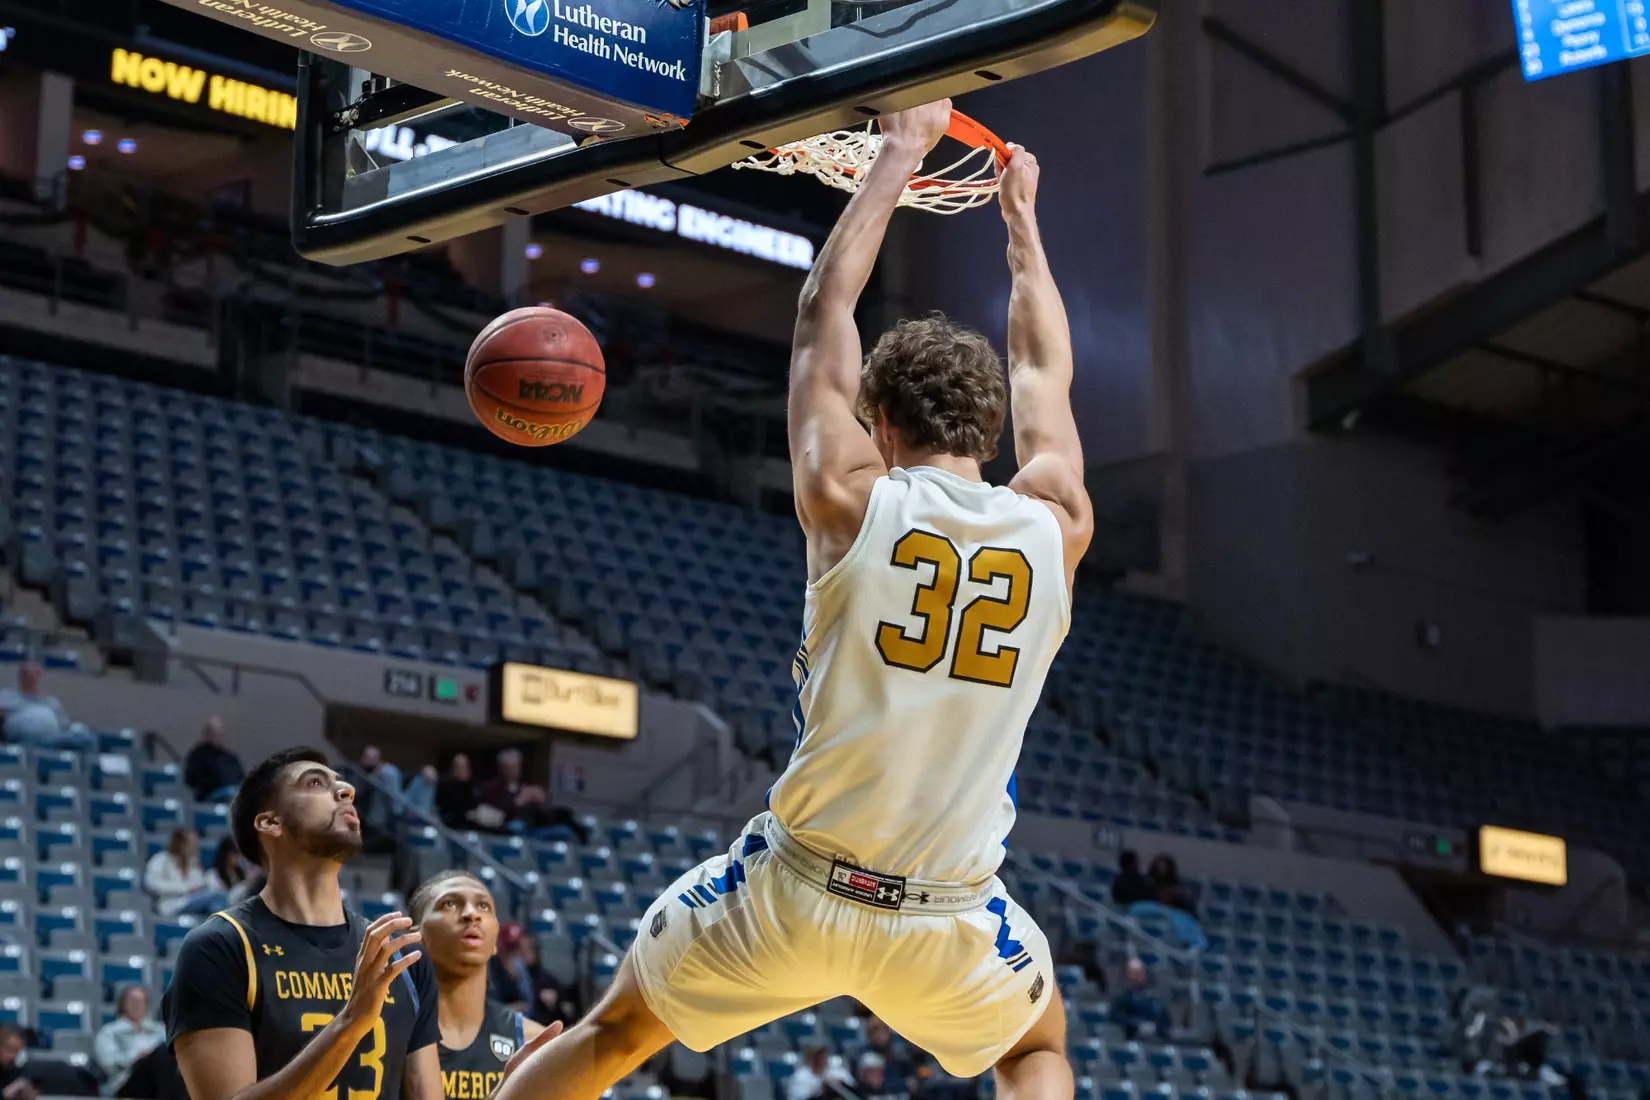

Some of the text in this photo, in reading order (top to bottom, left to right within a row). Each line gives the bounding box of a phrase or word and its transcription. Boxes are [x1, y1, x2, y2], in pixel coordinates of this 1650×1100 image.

[198, 0, 308, 37] Lutheran
[257, 6, 327, 31] Health
[553, 0, 647, 44] Lutheran
[553, 24, 686, 81] Health Network
[111, 47, 207, 104] NOW
[445, 69, 587, 117] Health Network
[469, 88, 568, 120] Lutheran
[518, 378, 585, 404] NCAA
[494, 407, 584, 440] Wilson
[875, 527, 1034, 689] 32
[800, 856, 830, 878] NDER
[275, 970, 395, 1004] COMME
